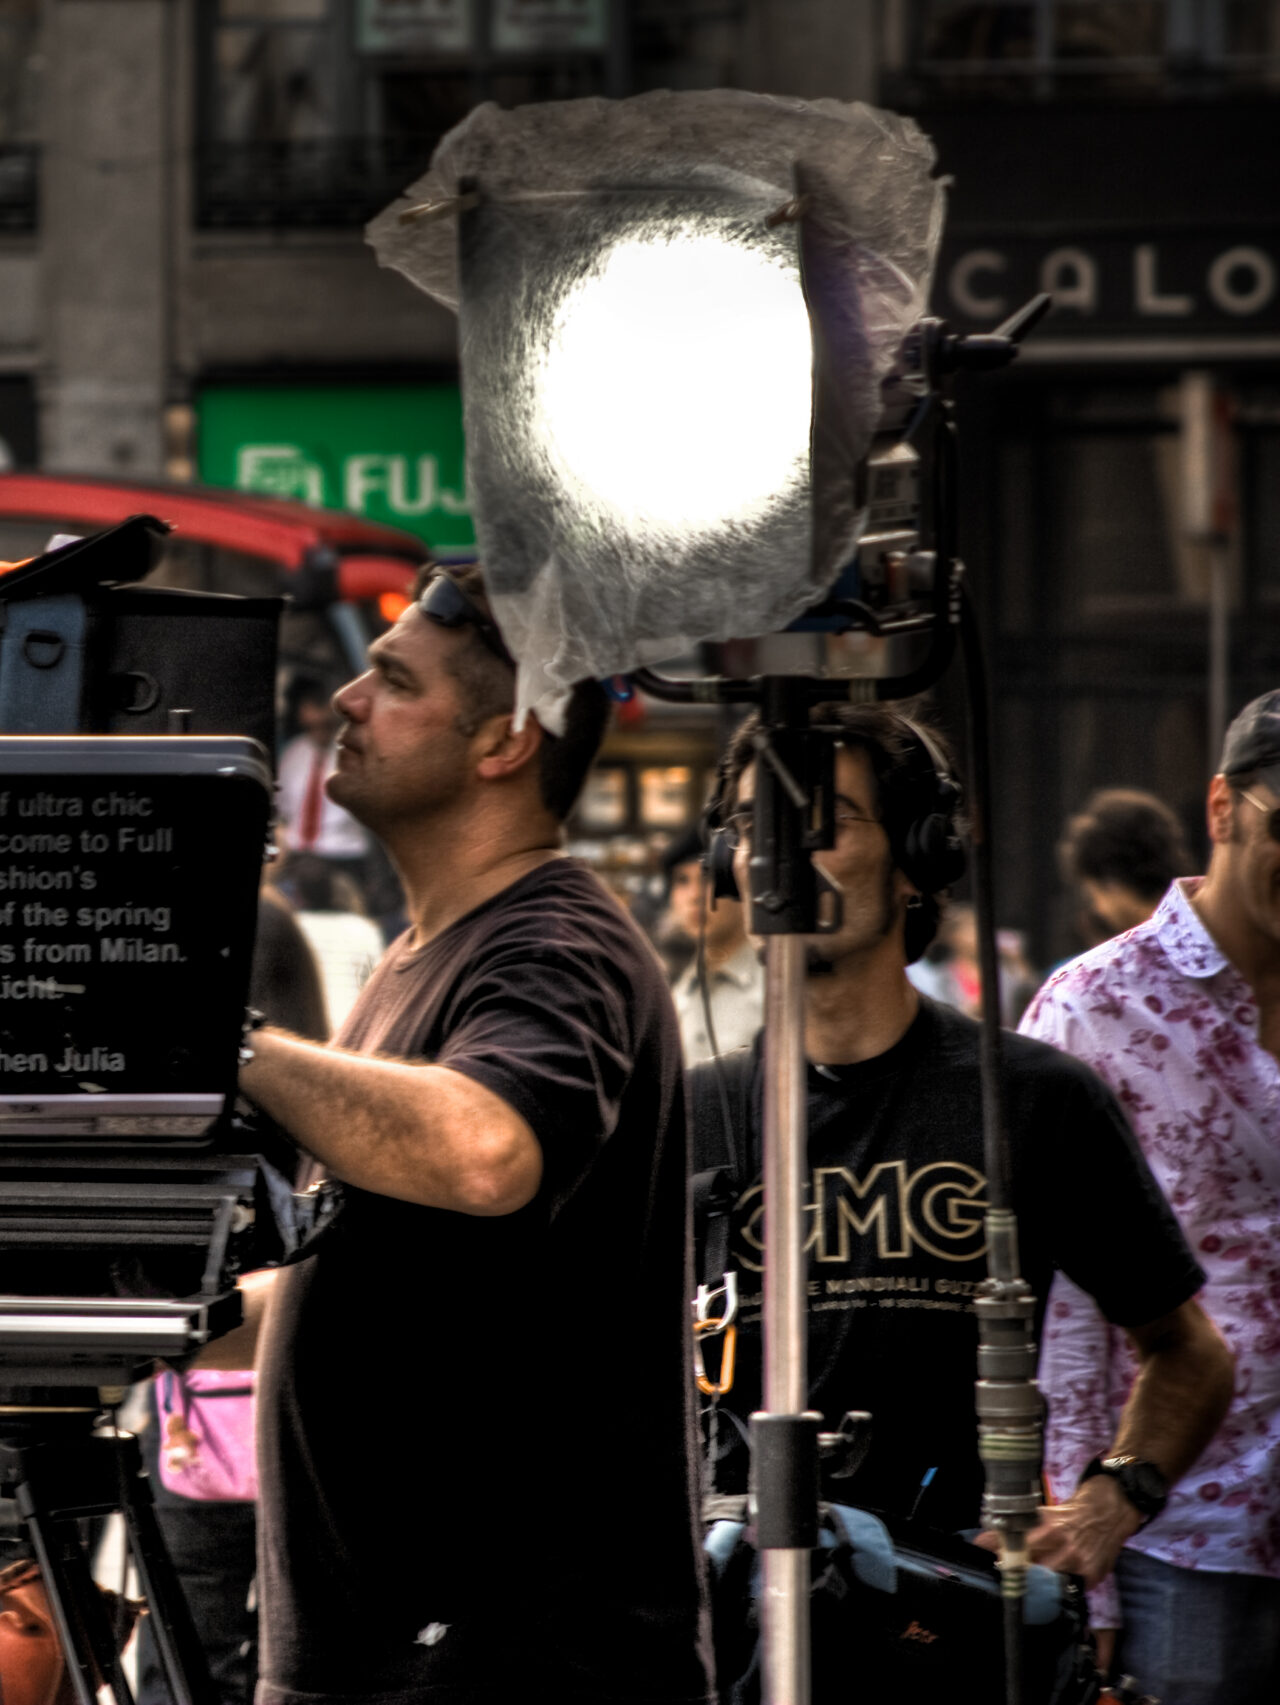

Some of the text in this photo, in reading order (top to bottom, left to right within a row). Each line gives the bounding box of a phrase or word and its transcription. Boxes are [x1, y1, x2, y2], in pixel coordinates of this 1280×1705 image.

[18, 792, 83, 817] ultra
[91, 791, 153, 817] chic
[79, 831, 110, 853] to
[118, 827, 173, 853] Full
[21, 901, 70, 927] the
[76, 901, 171, 932] spring
[22, 937, 92, 964] from
[99, 936, 188, 963] Milan.
[53, 1045, 126, 1073] Julia
